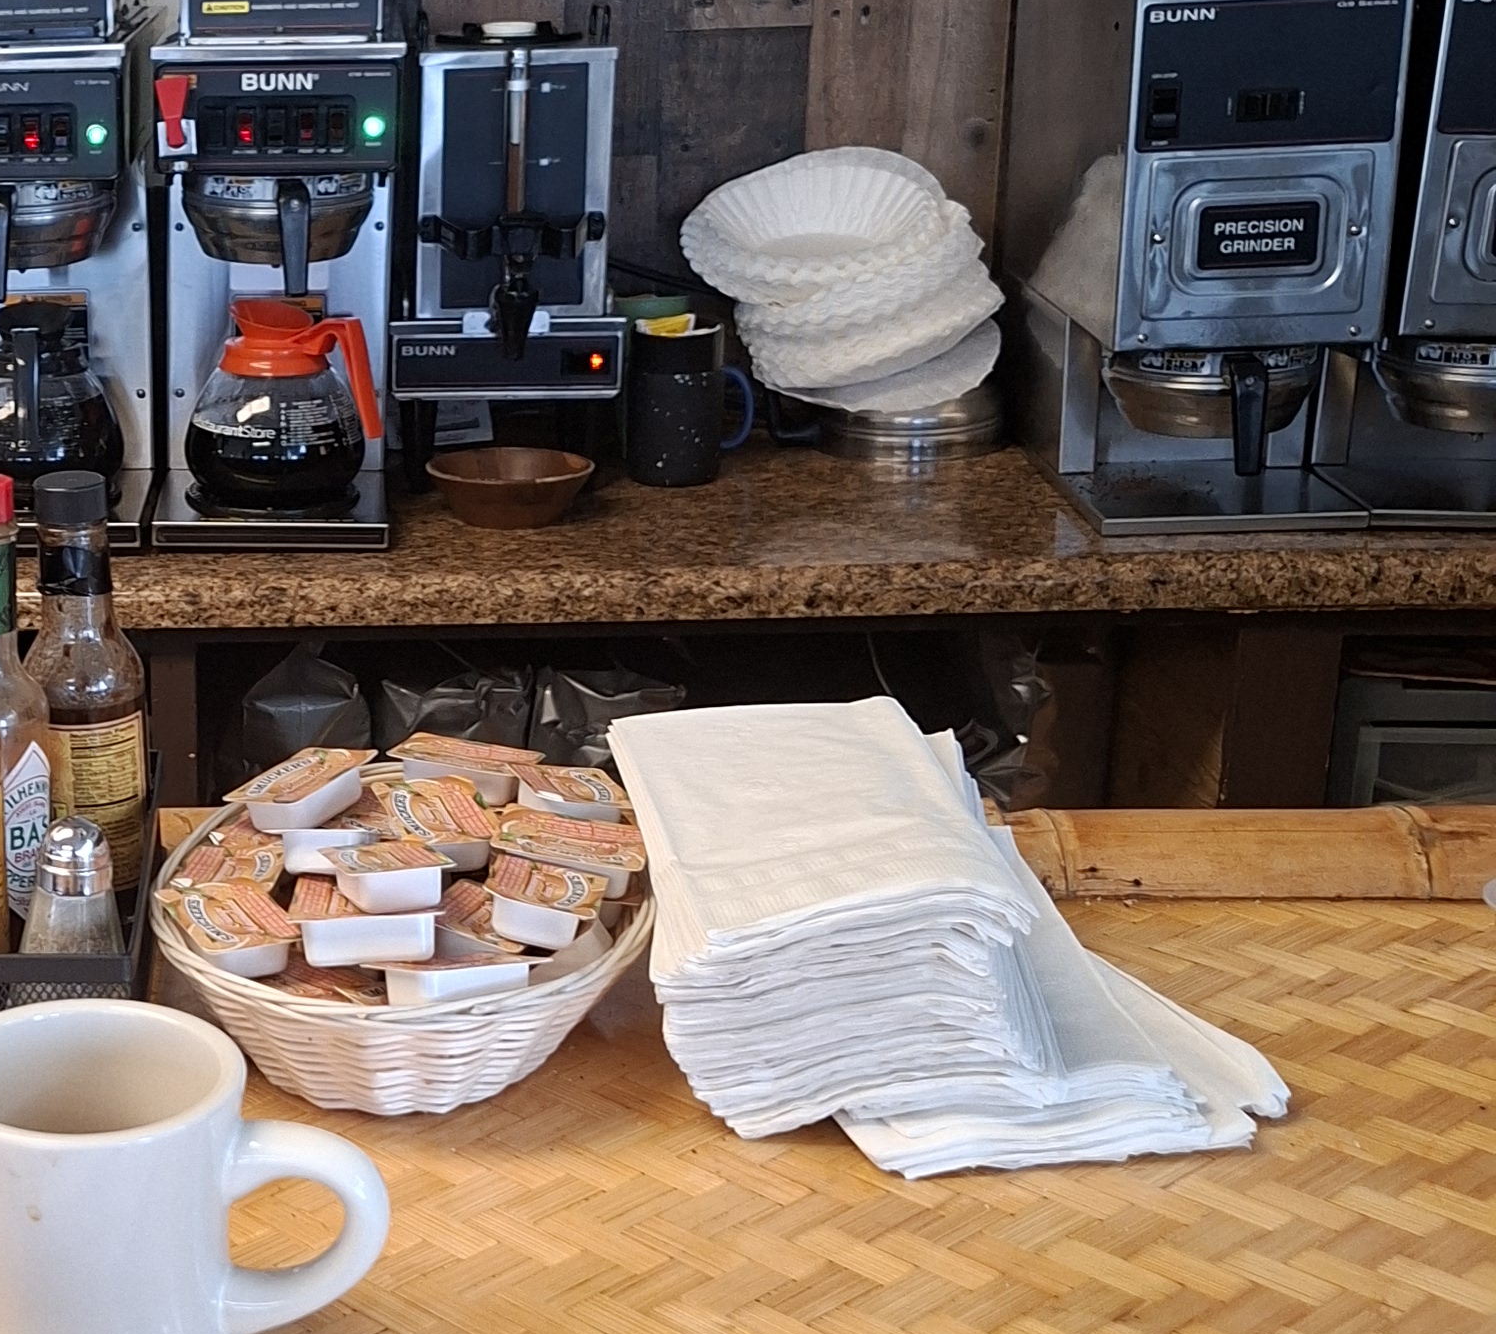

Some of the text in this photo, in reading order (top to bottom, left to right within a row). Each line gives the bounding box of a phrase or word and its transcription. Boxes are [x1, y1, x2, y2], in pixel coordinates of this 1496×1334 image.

[1149, 8, 1216, 24] BUNN
[241, 73, 314, 92] BUNN
[1213, 217, 1305, 236] PRECISION
[1219, 236, 1296, 254] GRINDER
[401, 345, 456, 357] BUNN
